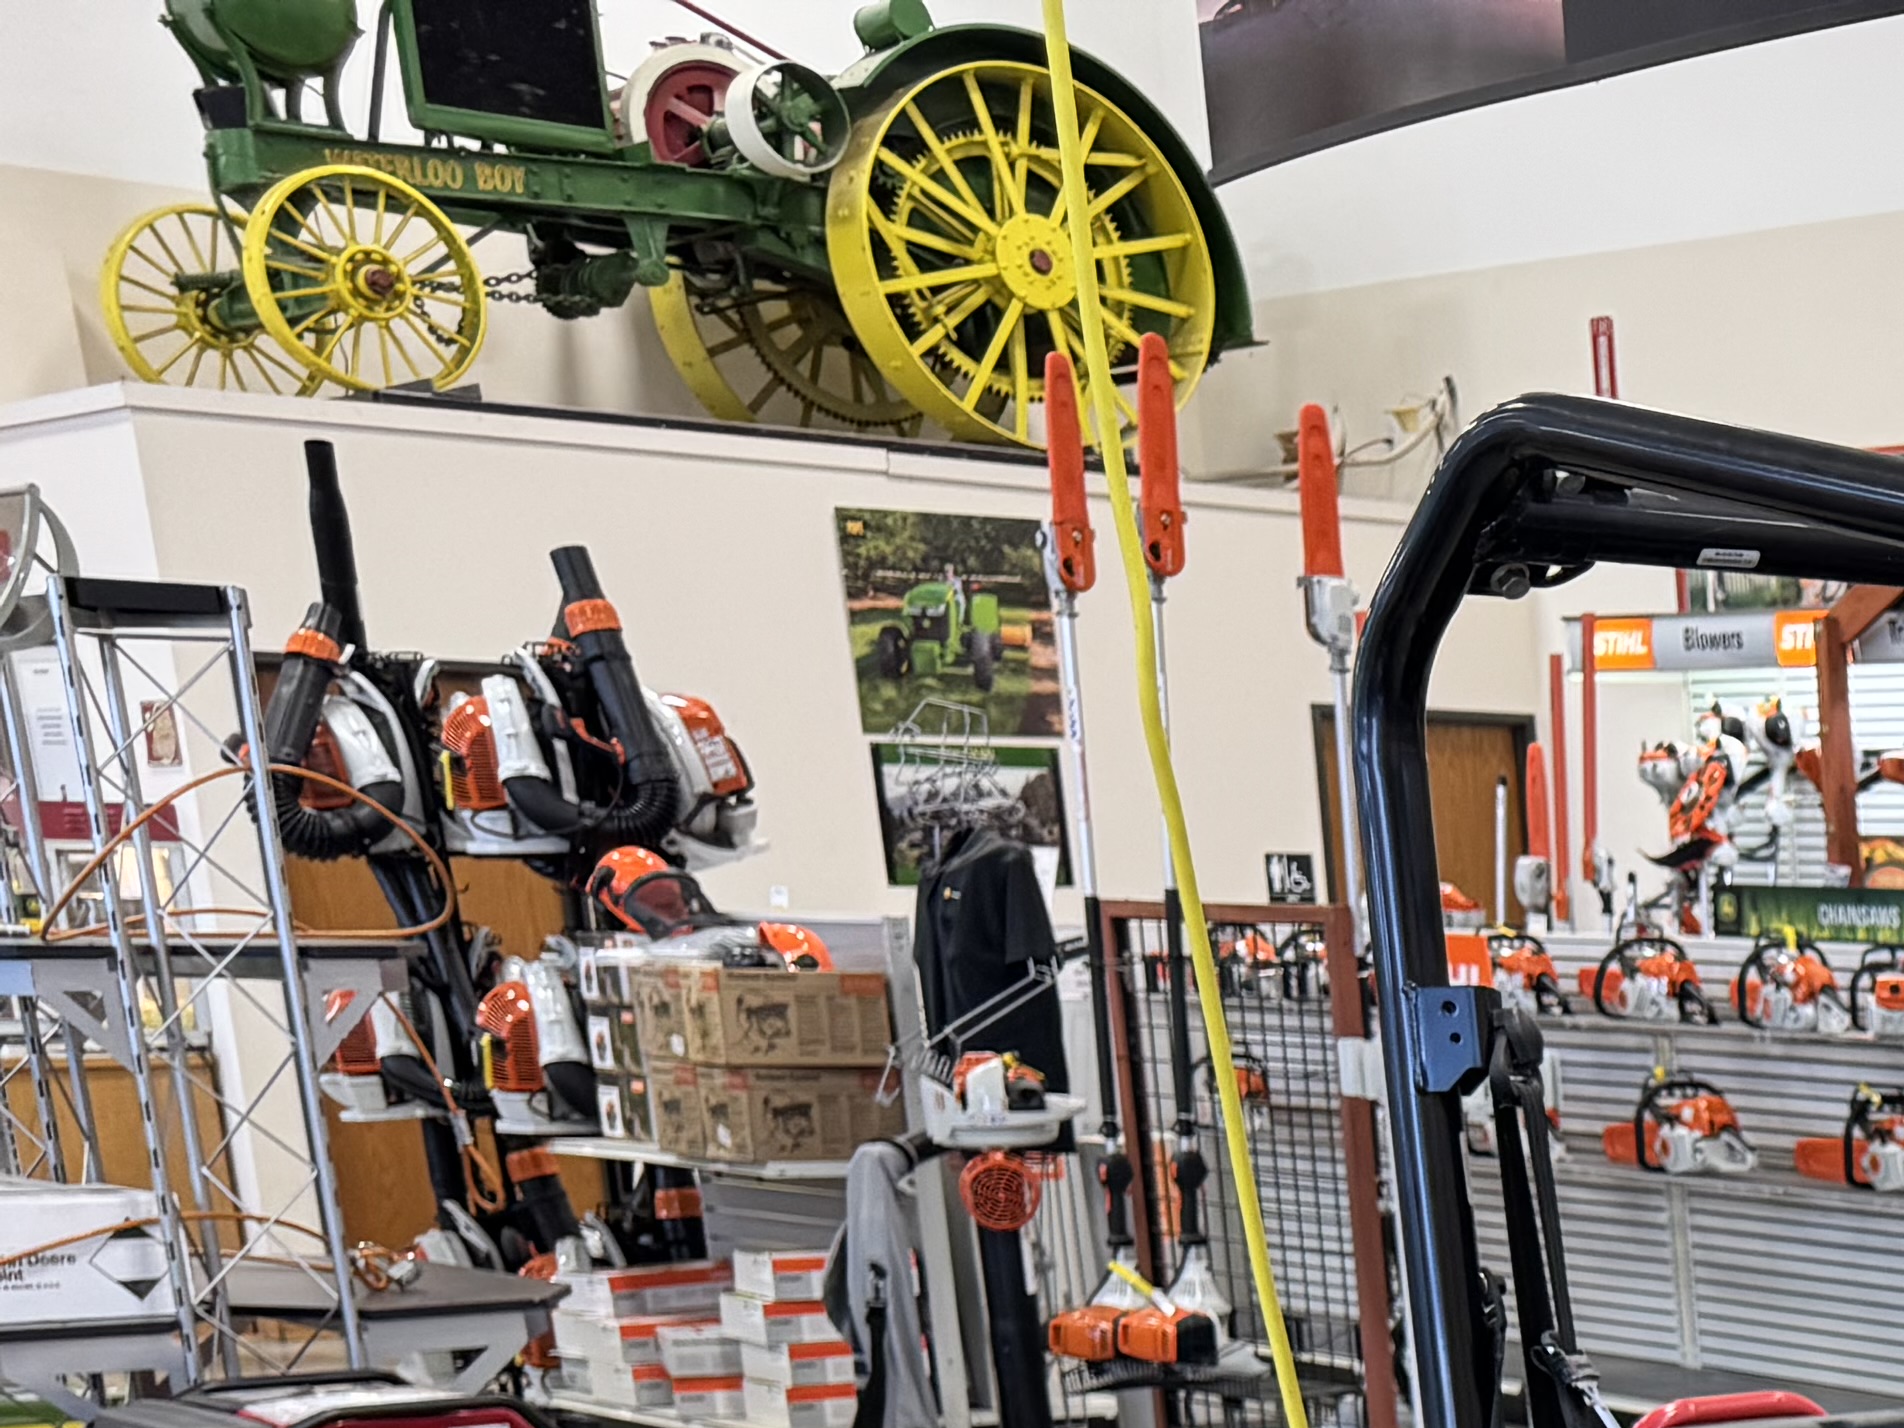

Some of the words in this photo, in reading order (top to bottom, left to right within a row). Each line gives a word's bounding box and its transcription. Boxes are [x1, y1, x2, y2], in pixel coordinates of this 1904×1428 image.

[475, 161, 526, 194] BOY
[1594, 631, 1648, 656] STIHL
[1683, 626, 1744, 652] Blowers
[1781, 623, 1815, 650] STI
